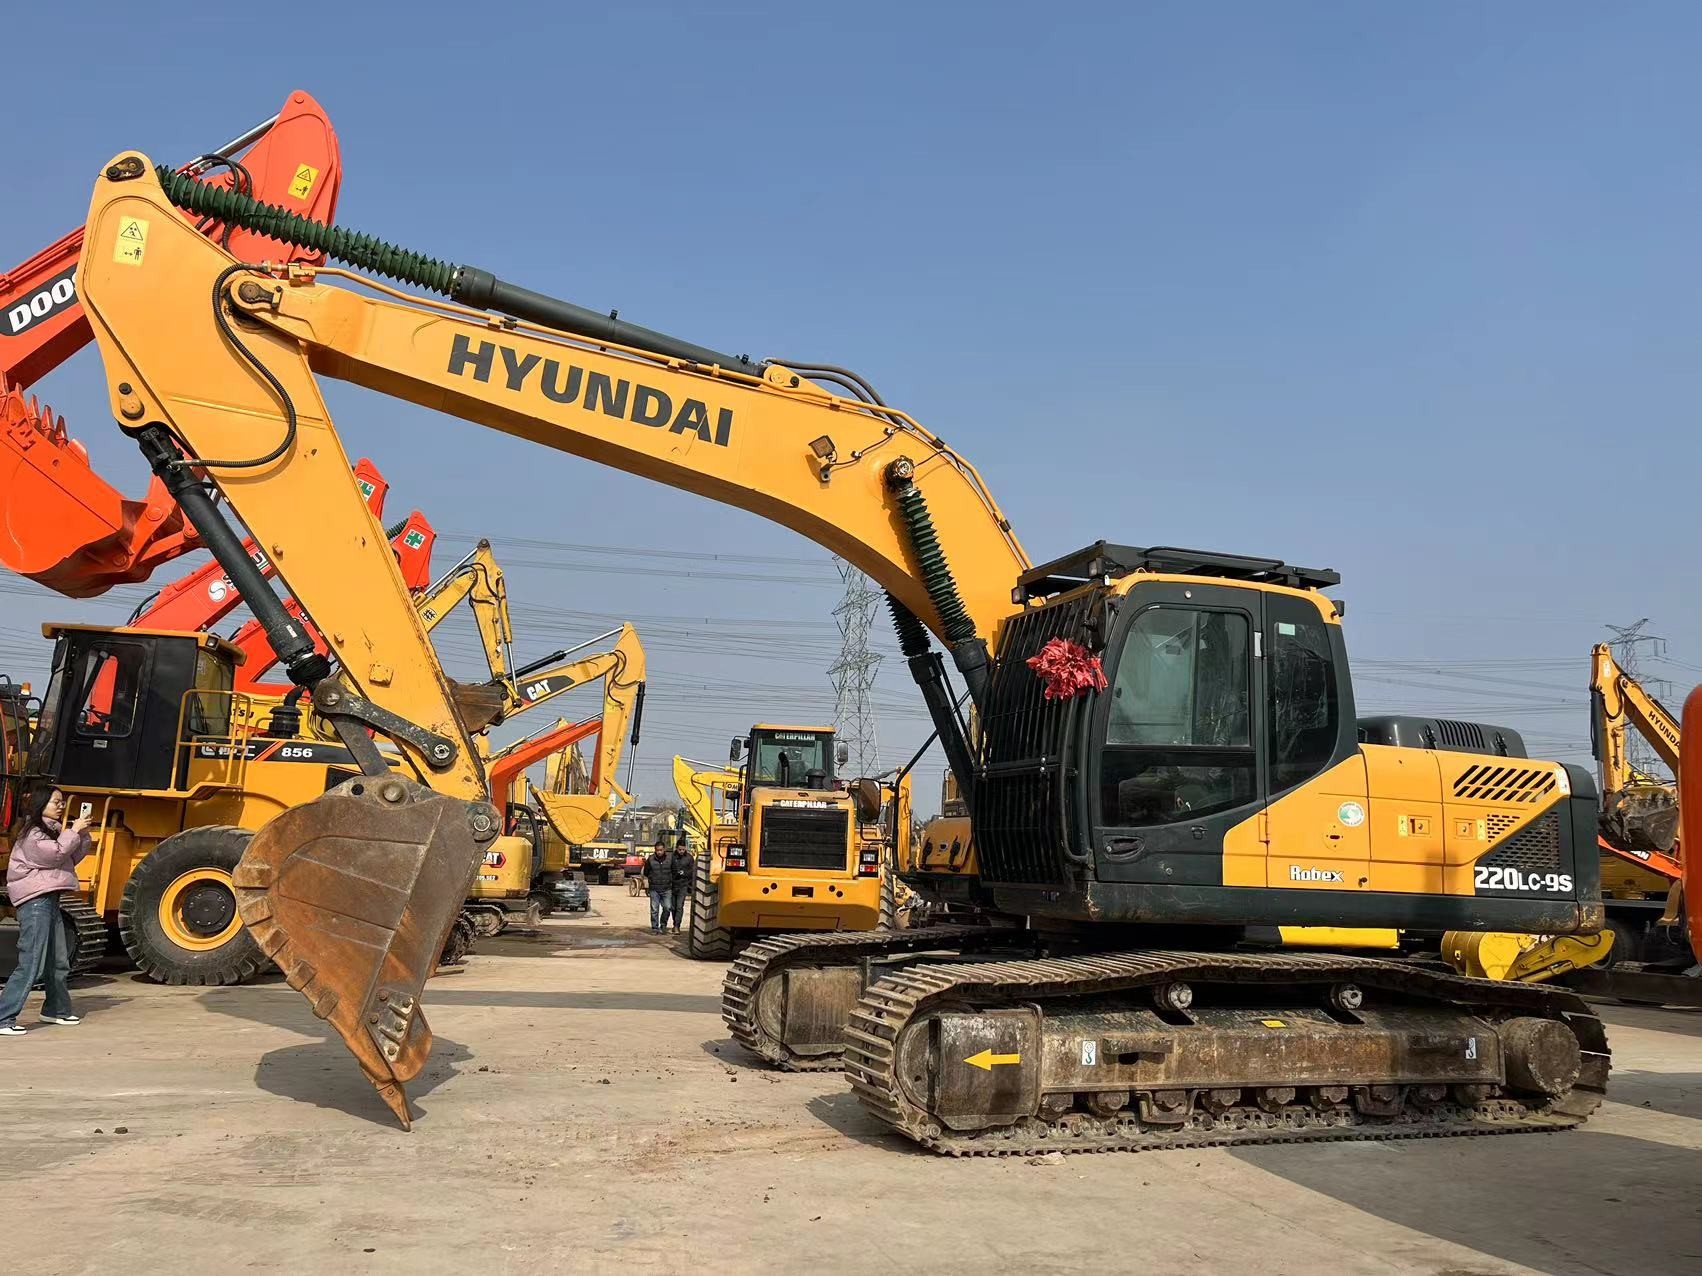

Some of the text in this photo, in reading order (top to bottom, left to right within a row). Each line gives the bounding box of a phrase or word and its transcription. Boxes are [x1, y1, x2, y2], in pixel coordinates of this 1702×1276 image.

[8, 272, 76, 333] DOO
[447, 333, 733, 447] HYUNDAI
[526, 679, 551, 700] CAT
[774, 732, 816, 741] CATERPILLAR
[281, 747, 313, 758] 856
[780, 799, 827, 809] CATERPILLAR
[593, 848, 609, 859] CAT
[1289, 865, 1344, 883] Robex
